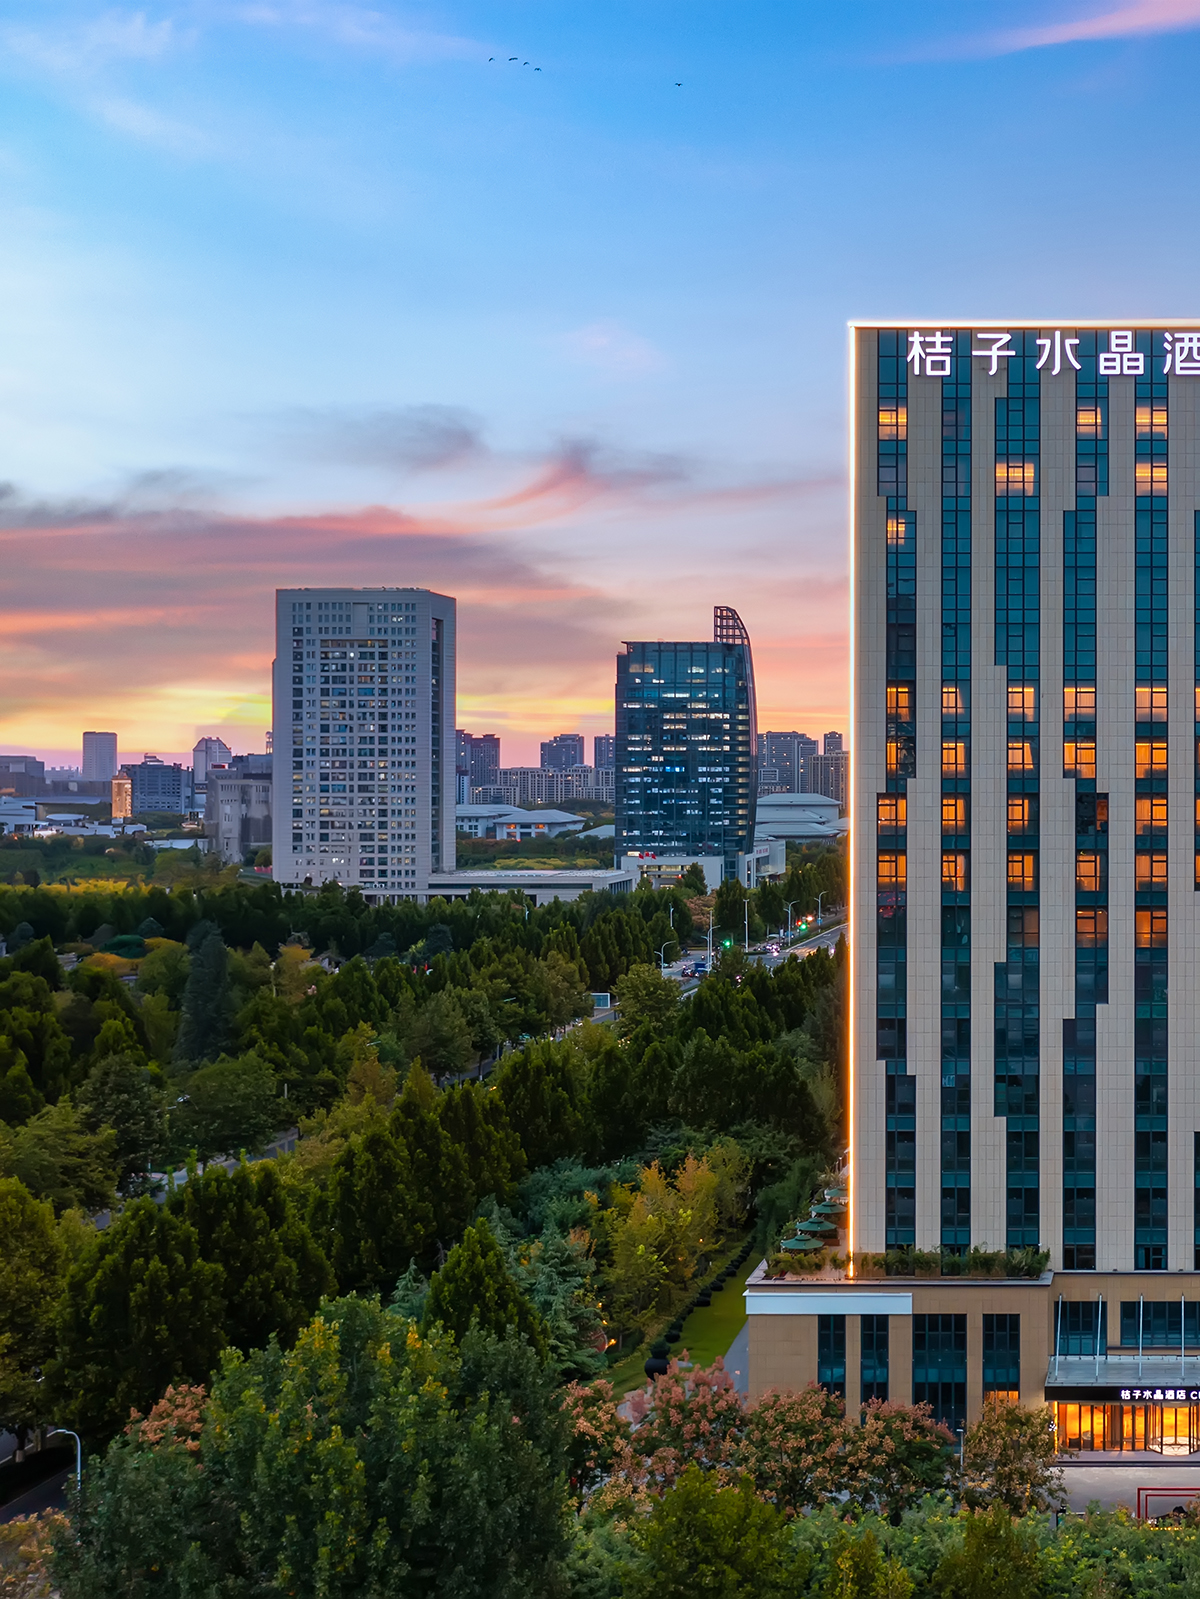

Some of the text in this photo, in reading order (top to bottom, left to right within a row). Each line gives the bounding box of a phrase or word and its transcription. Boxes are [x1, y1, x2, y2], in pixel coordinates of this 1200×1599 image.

[1120, 1389, 1186, 1400] 桔子水晶酒店
